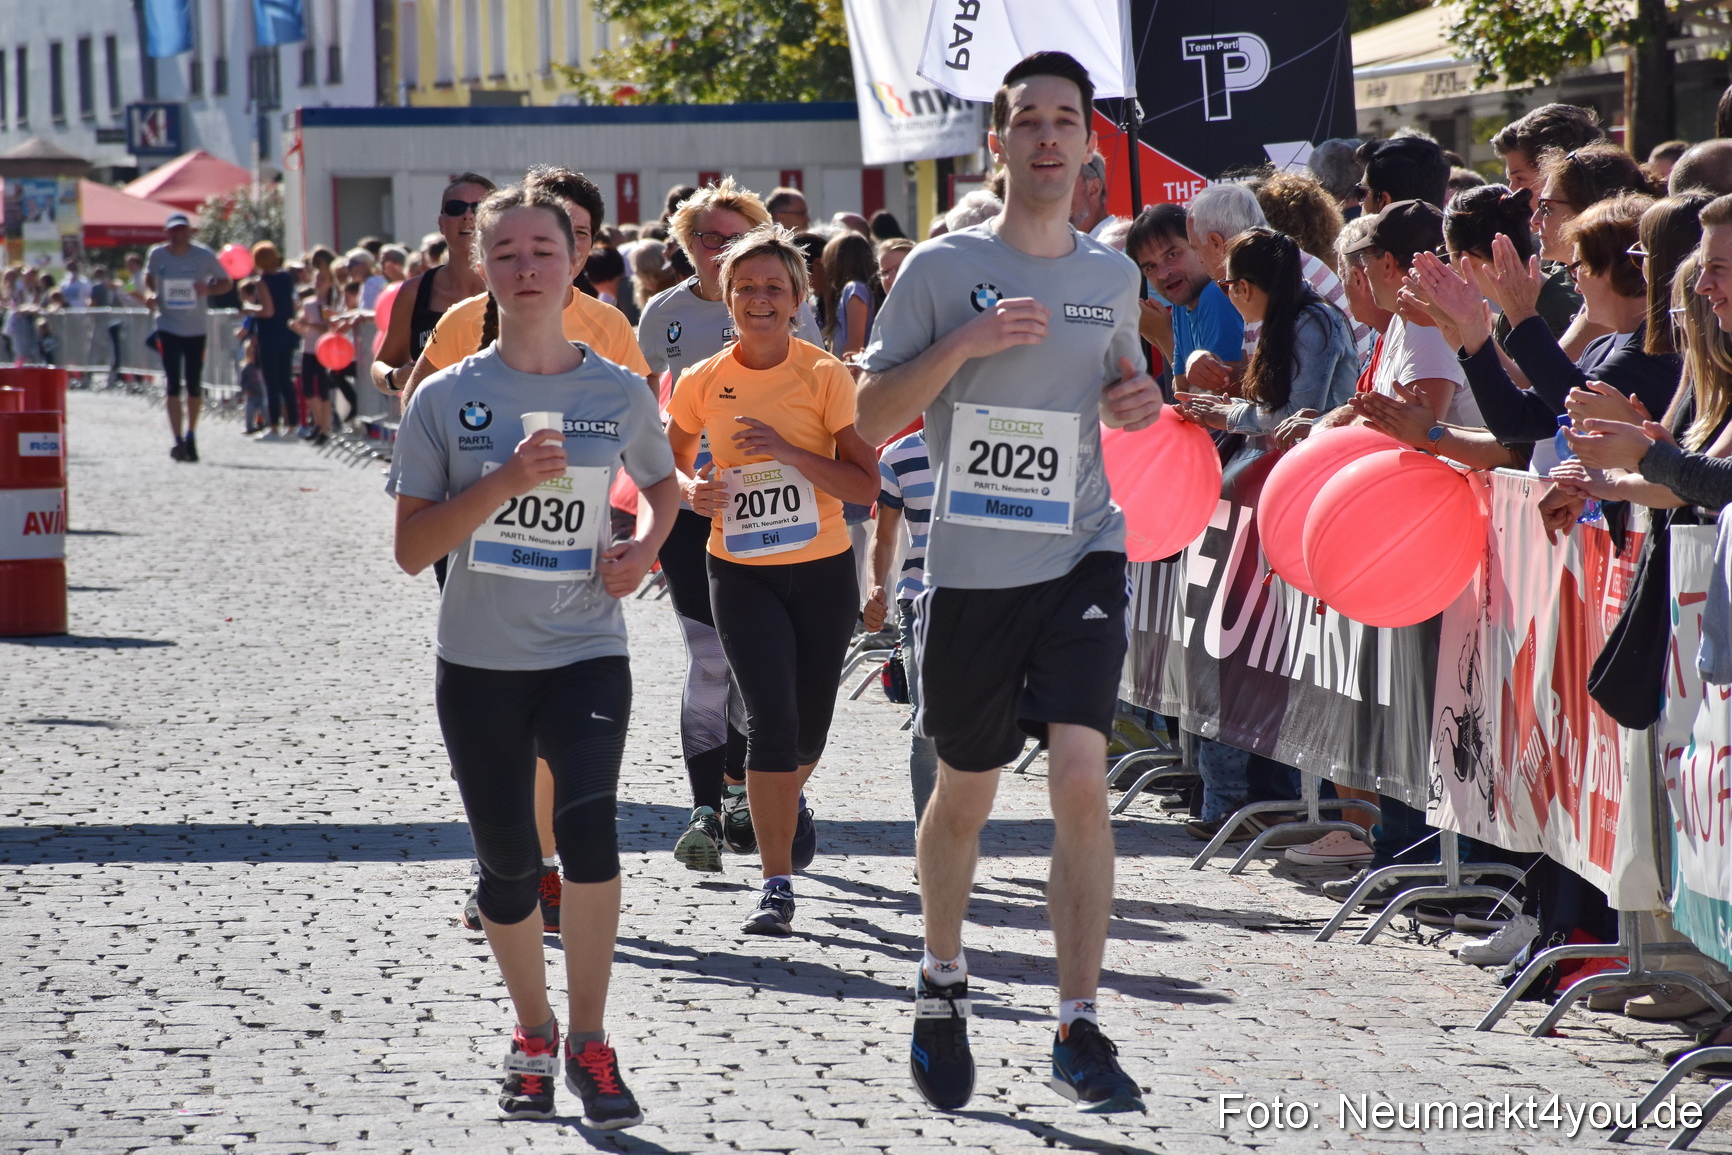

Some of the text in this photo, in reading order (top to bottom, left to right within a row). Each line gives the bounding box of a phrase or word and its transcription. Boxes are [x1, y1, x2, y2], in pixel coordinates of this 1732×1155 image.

[1188, 40, 1239, 52] Team Partl
[1163, 180, 1201, 200] THE
[1063, 303, 1115, 323] BOCK
[563, 419, 620, 437] BOCK
[988, 418, 1044, 435] BOCK
[458, 434, 494, 445] PARTL
[967, 439, 1059, 482] 2029
[743, 469, 783, 484] BOCK
[974, 481, 1039, 495] PARTL Neumarkt
[734, 484, 801, 521] 2070
[985, 499, 1034, 518] Marco
[493, 495, 585, 533] 2030
[741, 518, 790, 530] PARTL Neumarkt
[500, 531, 566, 546] PARTL Neumarkt
[762, 531, 780, 545] Evi
[511, 549, 558, 569] Selina
